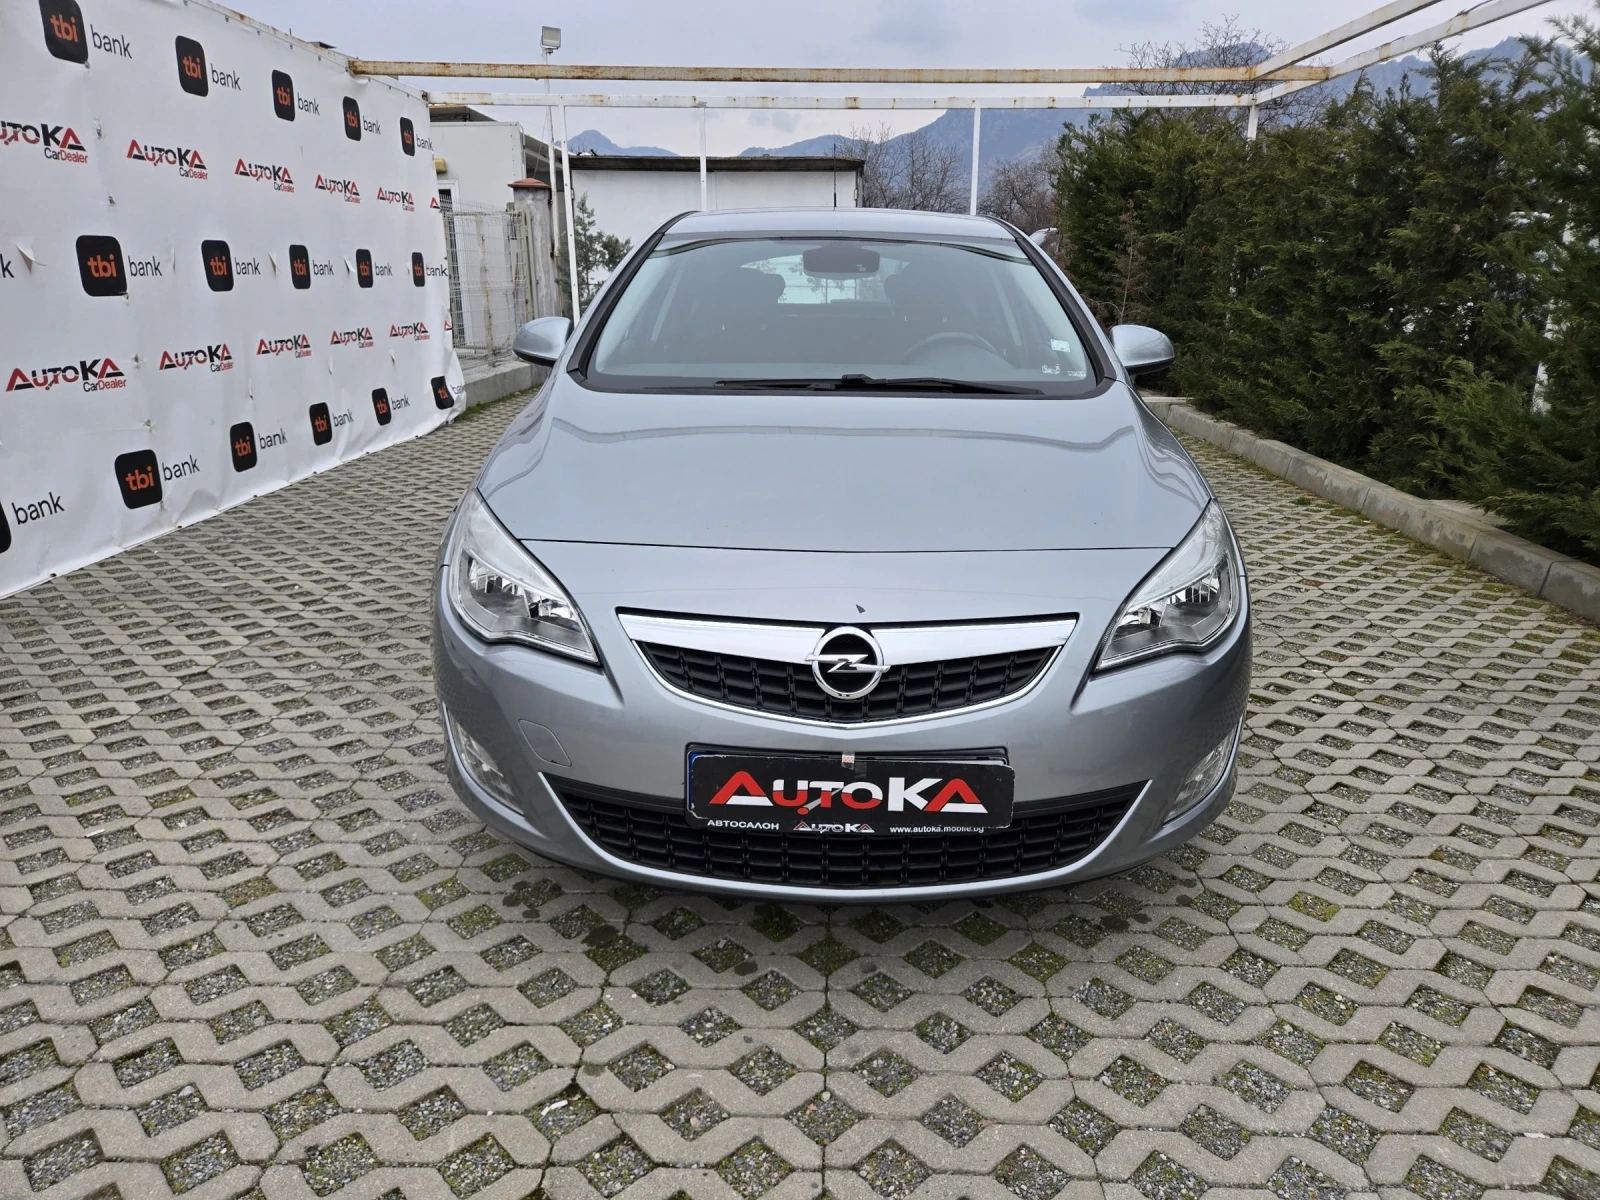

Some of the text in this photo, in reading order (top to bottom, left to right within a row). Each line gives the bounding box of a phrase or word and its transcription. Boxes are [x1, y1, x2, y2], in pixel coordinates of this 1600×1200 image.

[51, 14, 133, 59] tbi bank
[182, 56, 241, 91] tbi bank
[276, 87, 320, 116] tbi bank
[346, 111, 381, 135] tbi bank
[403, 130, 433, 151] tbi bank
[44, 147, 88, 164] CarDealer
[179, 167, 208, 180] CarDealer
[87, 254, 163, 278] tbi bank
[209, 256, 261, 276] tbi bank
[293, 258, 334, 276] tbi bank
[359, 261, 392, 276] tbi bank
[426, 264, 448, 277] bank
[210, 361, 234, 373] CarDealer
[82, 378, 127, 392] CarDealer
[376, 394, 411, 414] tbi bank
[314, 409, 354, 433] tbi bank
[234, 428, 288, 457] tbi bank
[125, 454, 201, 491] tbi bank
[11, 491, 66, 525] bank
[707, 819, 779, 830] АВТОСАЛОН
